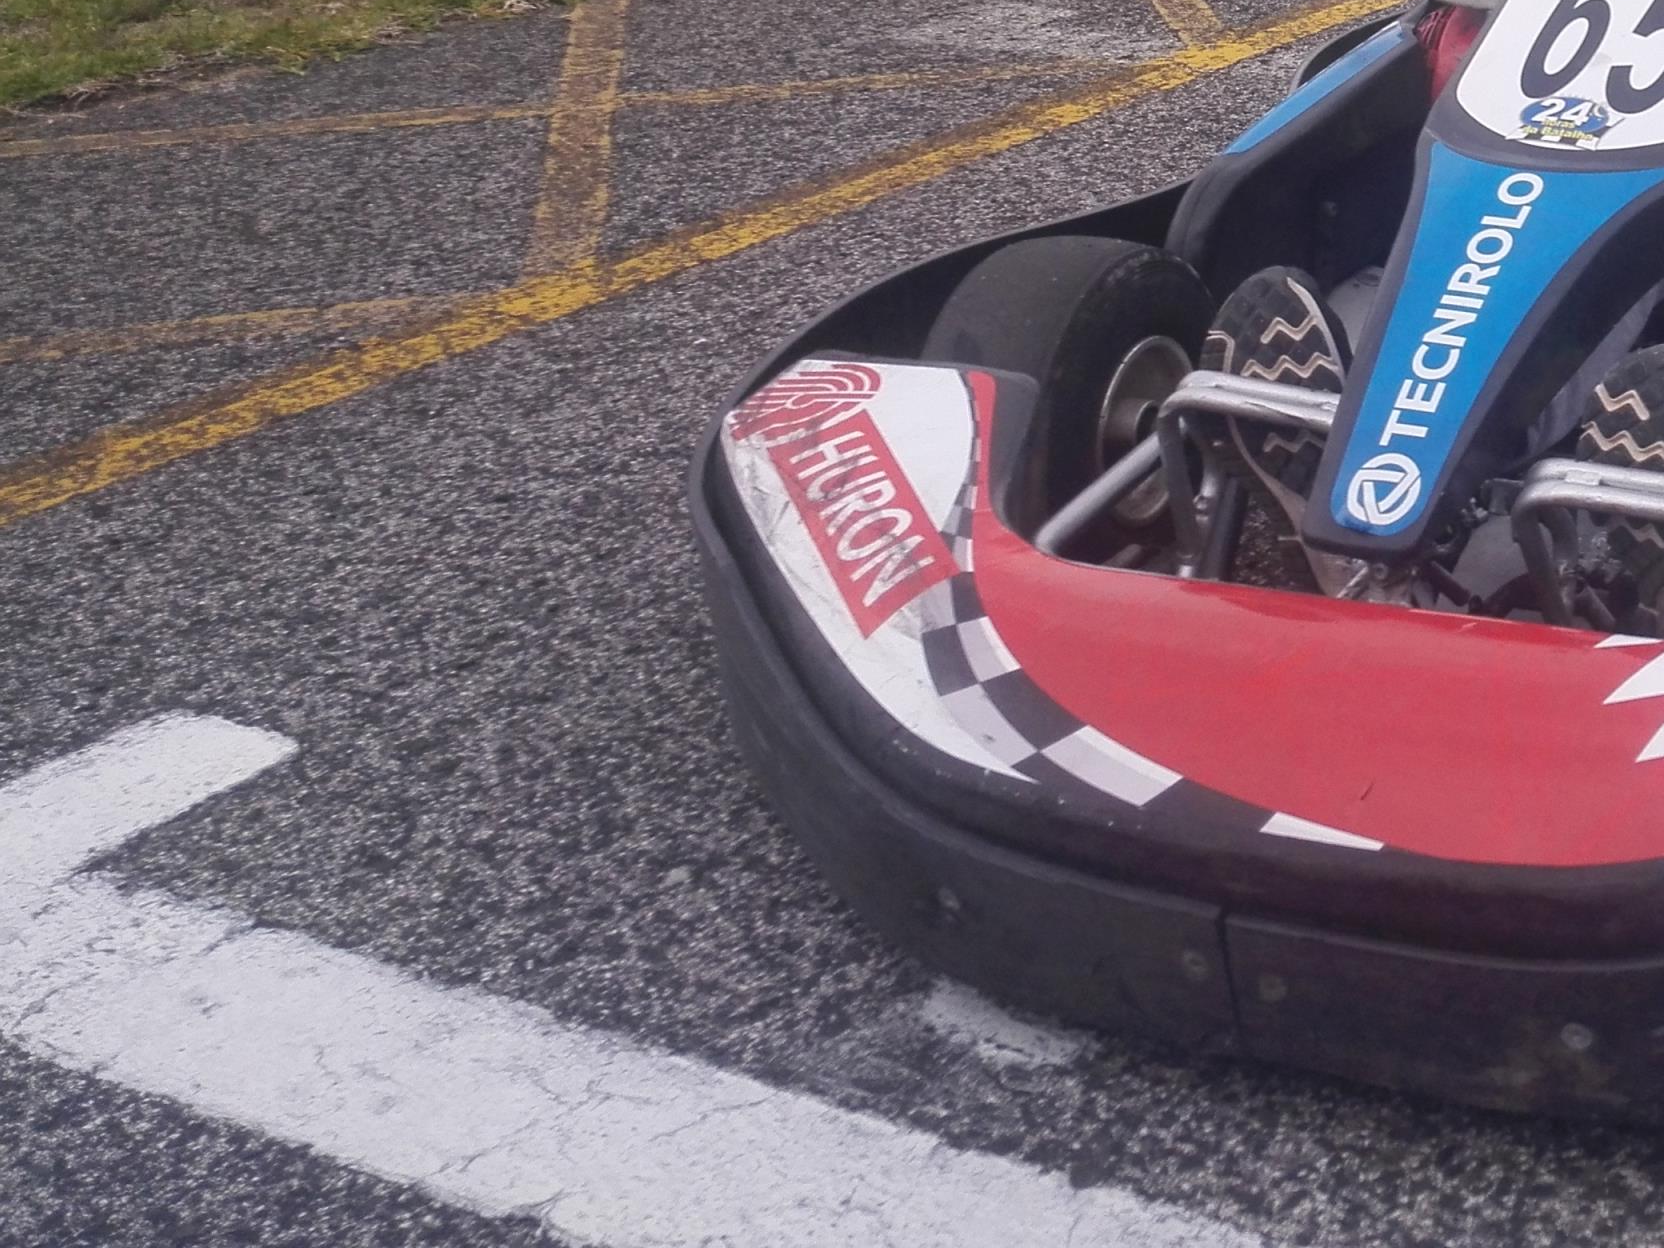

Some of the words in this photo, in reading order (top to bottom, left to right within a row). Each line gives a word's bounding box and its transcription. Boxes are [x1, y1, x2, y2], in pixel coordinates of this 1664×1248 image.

[1531, 98, 1594, 126] 24
[1379, 172, 1544, 446] TECNIROLO
[789, 430, 936, 608] HURON
